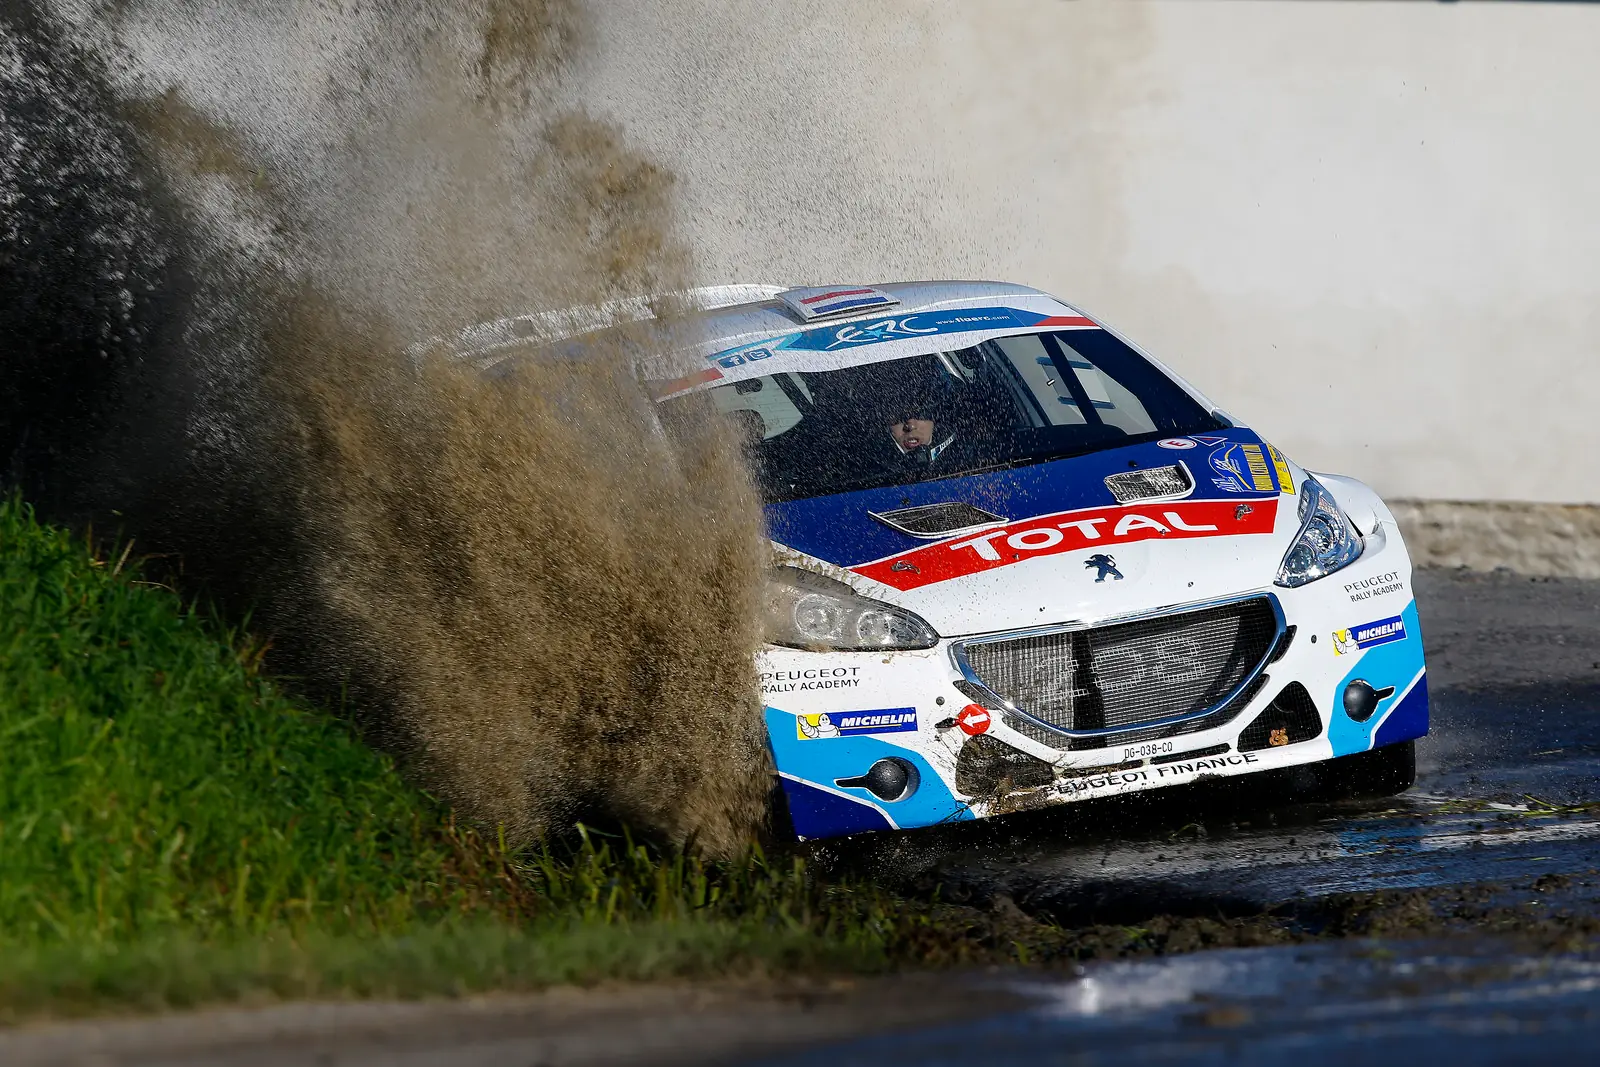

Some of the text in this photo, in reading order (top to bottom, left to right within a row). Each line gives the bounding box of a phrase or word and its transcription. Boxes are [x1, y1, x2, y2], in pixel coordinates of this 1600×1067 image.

[950, 511, 1219, 561] TOTAL
[1344, 571, 1400, 593] PEUGEOT
[1350, 582, 1404, 602] RALLY ACADEMY
[1357, 620, 1403, 641] MICHELIN
[760, 667, 861, 682] PEUGEOT
[761, 678, 860, 694] RALLY ACADEMY
[840, 713, 916, 727] MICHELIN
[1156, 752, 1259, 778] FINANCE
